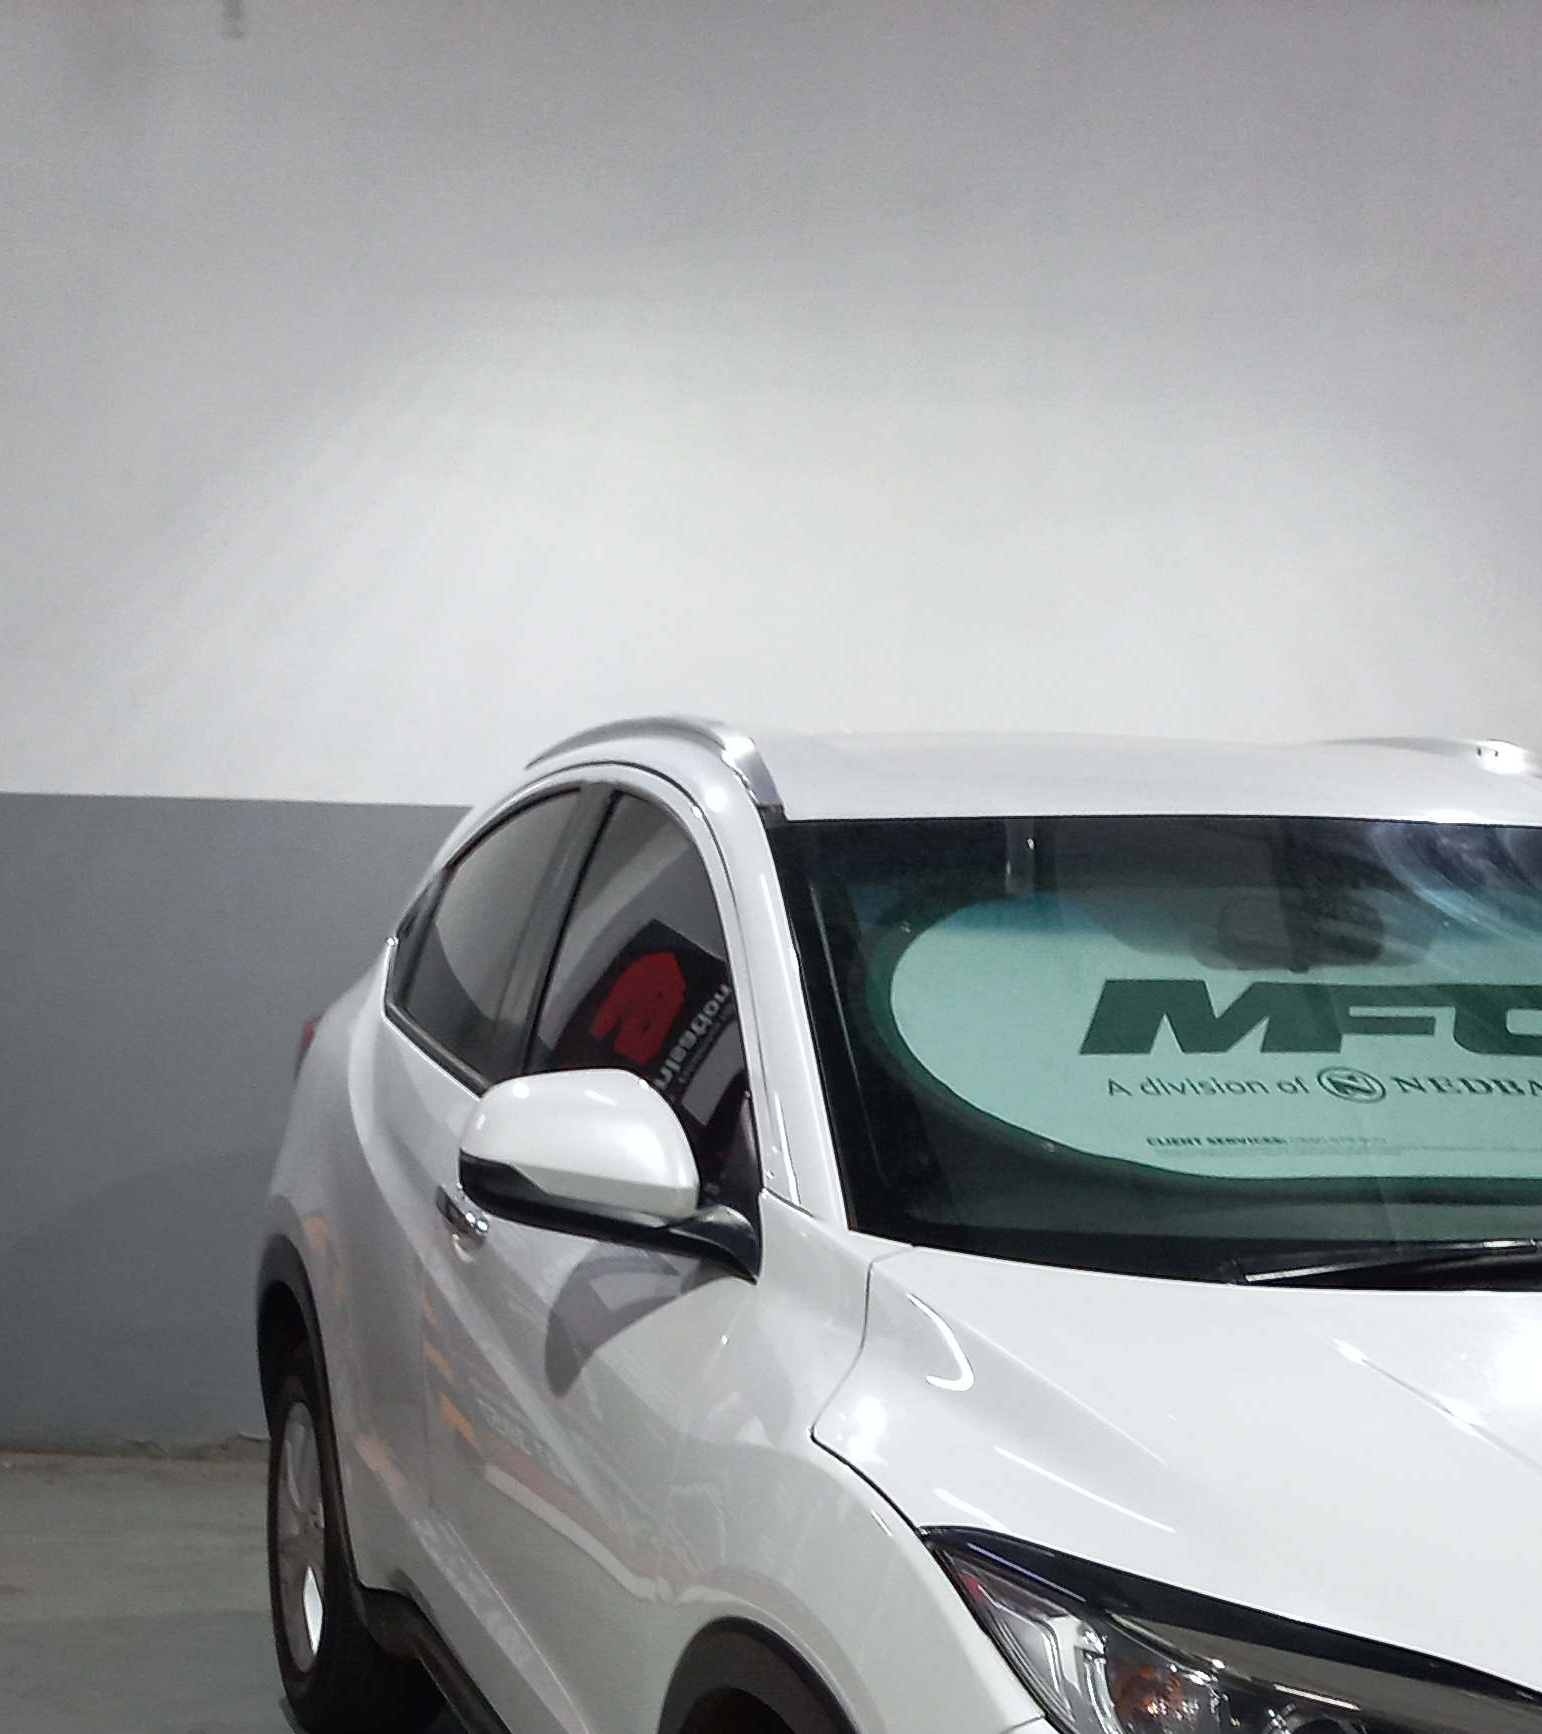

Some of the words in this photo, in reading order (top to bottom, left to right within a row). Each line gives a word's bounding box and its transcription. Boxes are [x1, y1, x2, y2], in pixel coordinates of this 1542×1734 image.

[1107, 1077, 1132, 1097] A
[1140, 1076, 1266, 1097] division
[1272, 1077, 1308, 1096] of
